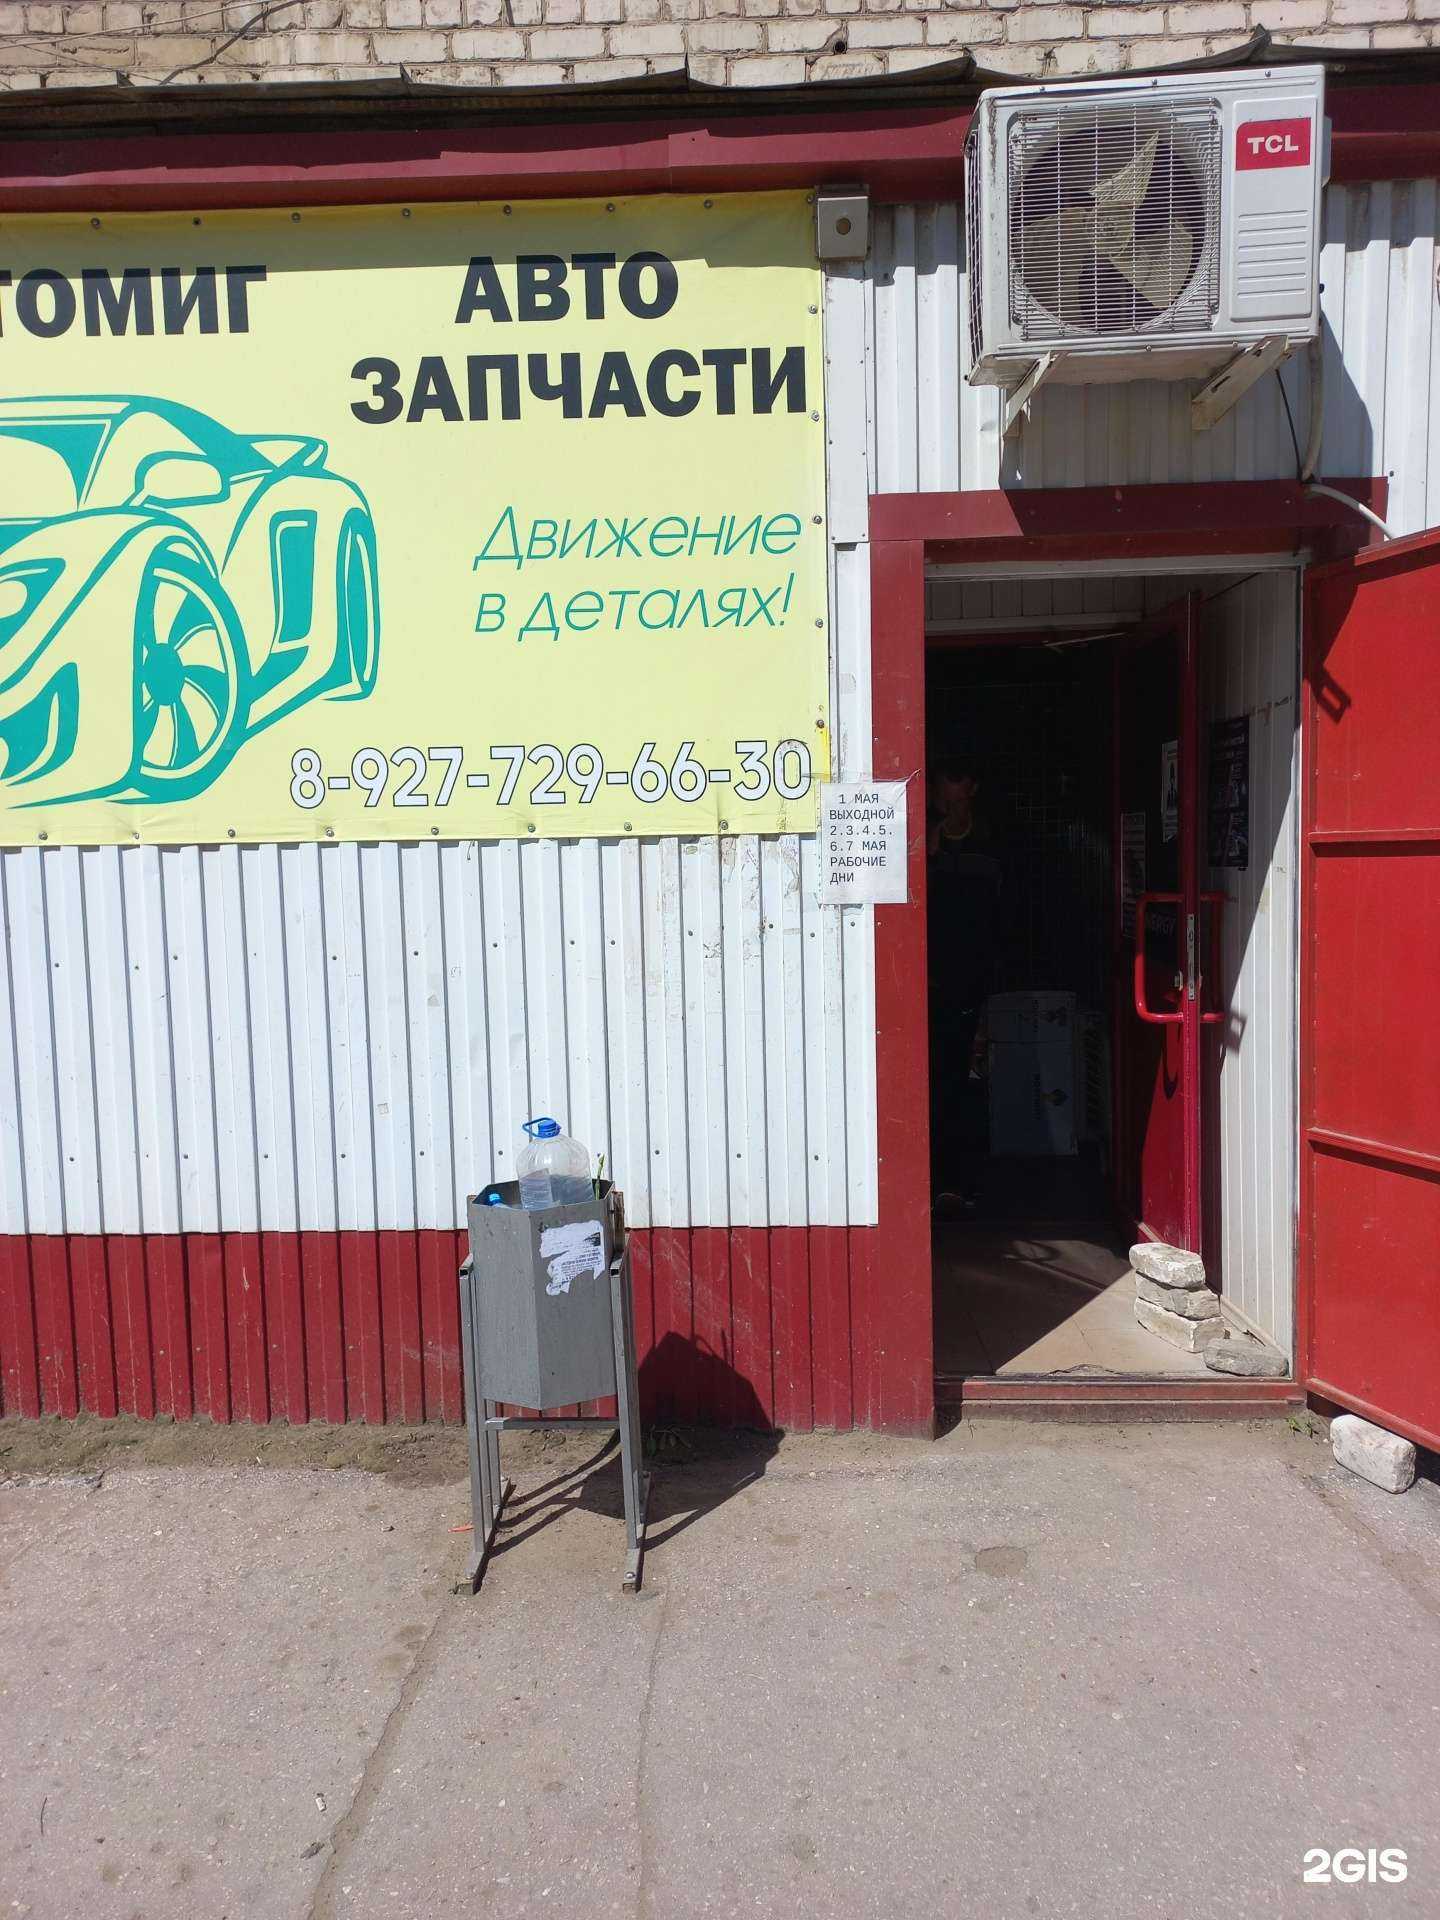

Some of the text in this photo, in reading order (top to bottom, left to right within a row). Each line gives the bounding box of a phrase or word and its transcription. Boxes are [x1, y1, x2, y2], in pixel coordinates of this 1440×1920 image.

[1247, 134, 1299, 155] TCL
[455, 251, 679, 325] АВТО
[350, 346, 807, 424] ЗАПЧАСТИ
[472, 506, 801, 571] Движение
[475, 572, 795, 642] в деталях!
[290, 739, 812, 809] 8-927-729-66-30
[839, 793, 880, 804] 1 МАЯ
[829, 806, 895, 822] ВЫХОДНОЙ
[830, 841, 887, 852] 6.7 МАЯ
[830, 856, 887, 867] РАБОЧИЕ
[829, 872, 854, 885] ДНИ
